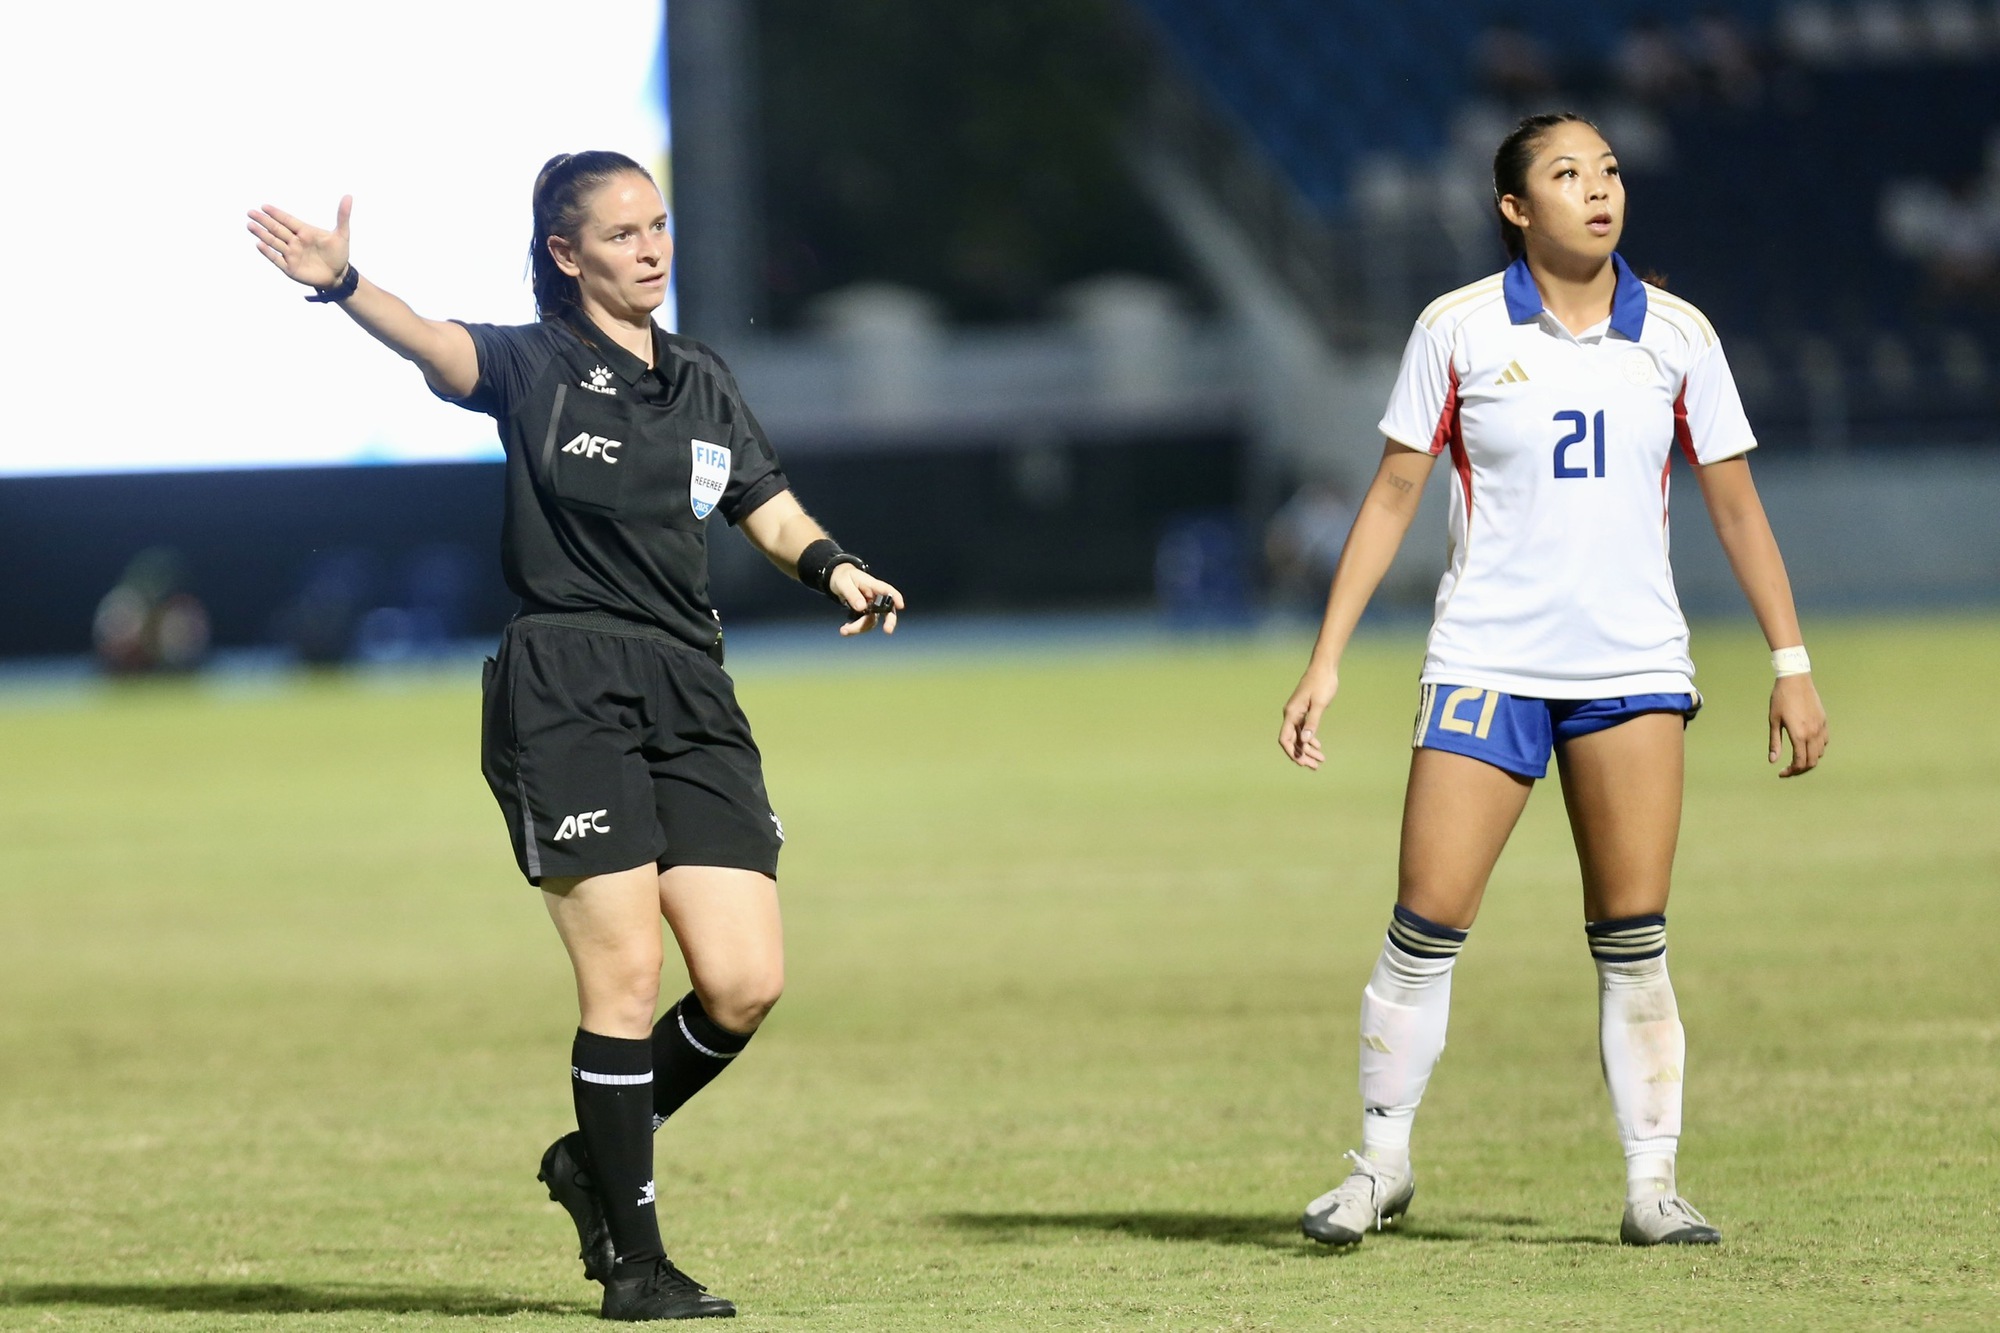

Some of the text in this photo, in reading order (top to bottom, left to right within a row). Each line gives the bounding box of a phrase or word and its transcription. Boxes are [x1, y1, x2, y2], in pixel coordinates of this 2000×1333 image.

[580, 380, 618, 396] KELME
[561, 432, 622, 464] AFC
[696, 446, 726, 470] FIFA
[1552, 409, 1606, 479] 21
[694, 475, 723, 492] REFEREE
[1439, 687, 1499, 740] 21
[553, 809, 611, 841] AFC
[637, 1194, 655, 1207] KEL
